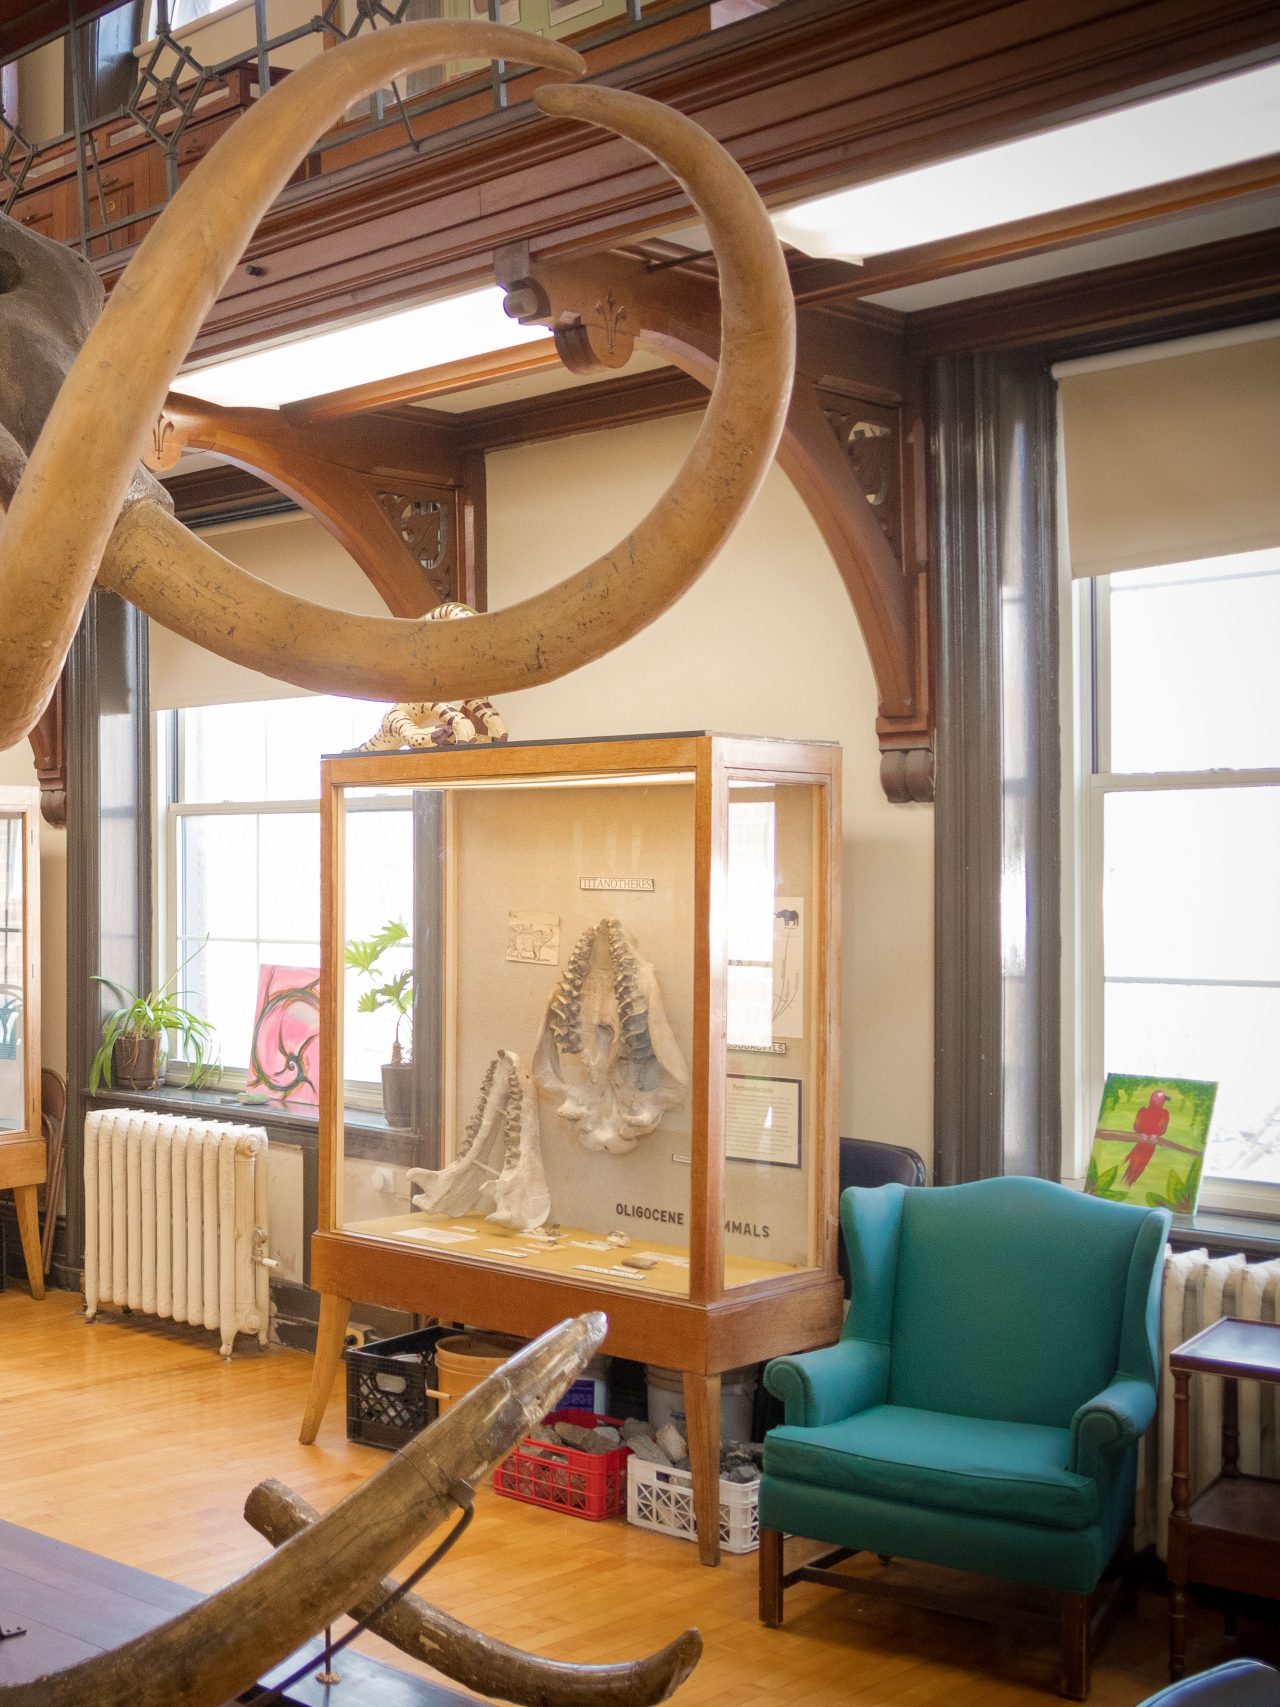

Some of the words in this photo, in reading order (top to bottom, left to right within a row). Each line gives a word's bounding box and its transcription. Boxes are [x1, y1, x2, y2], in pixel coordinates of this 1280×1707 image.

[583, 878, 652, 889] TITANOTHERES
[616, 1203, 685, 1225] OLIGOCENE
[724, 1219, 770, 1238] MMALS
